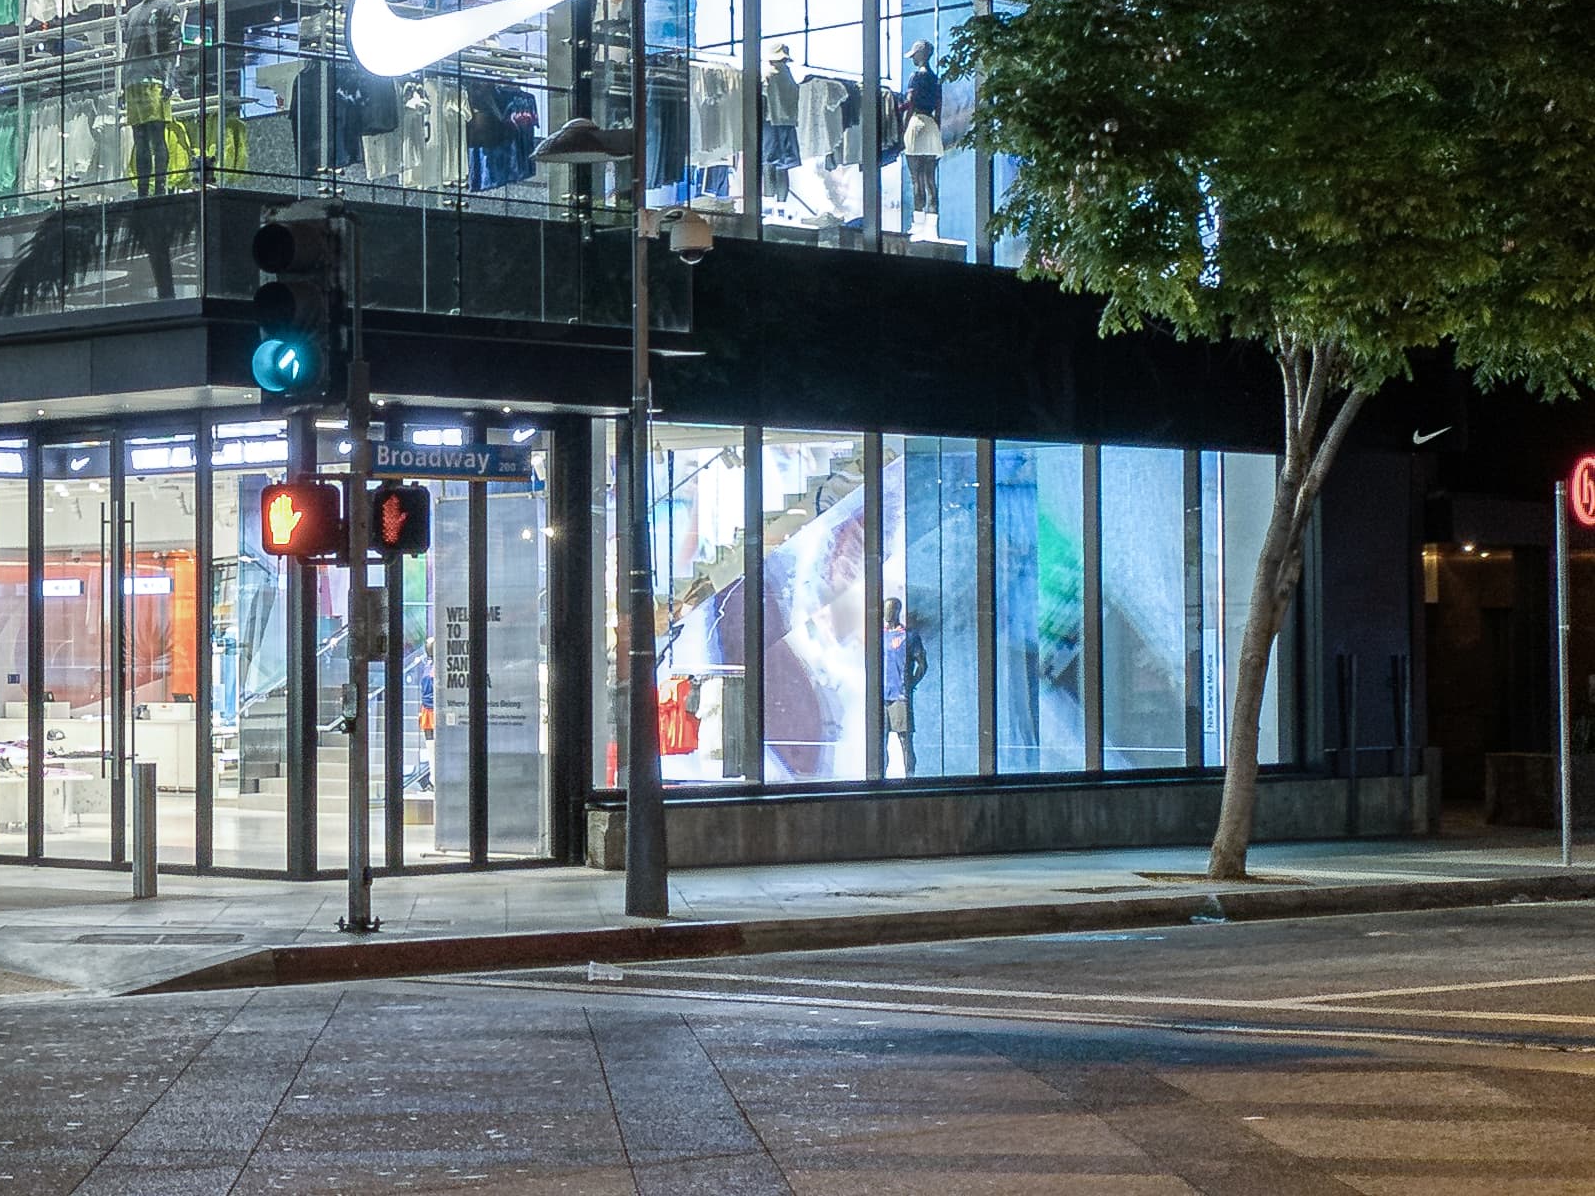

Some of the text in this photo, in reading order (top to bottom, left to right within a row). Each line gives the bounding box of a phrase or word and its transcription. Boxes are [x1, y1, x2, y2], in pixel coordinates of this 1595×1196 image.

[377, 444, 490, 474] Broadway
[498, 462, 516, 472] 200
[446, 606, 500, 622] WELME
[446, 623, 461, 638] TO
[446, 640, 470, 655] NIK
[446, 656, 470, 672] SAN
